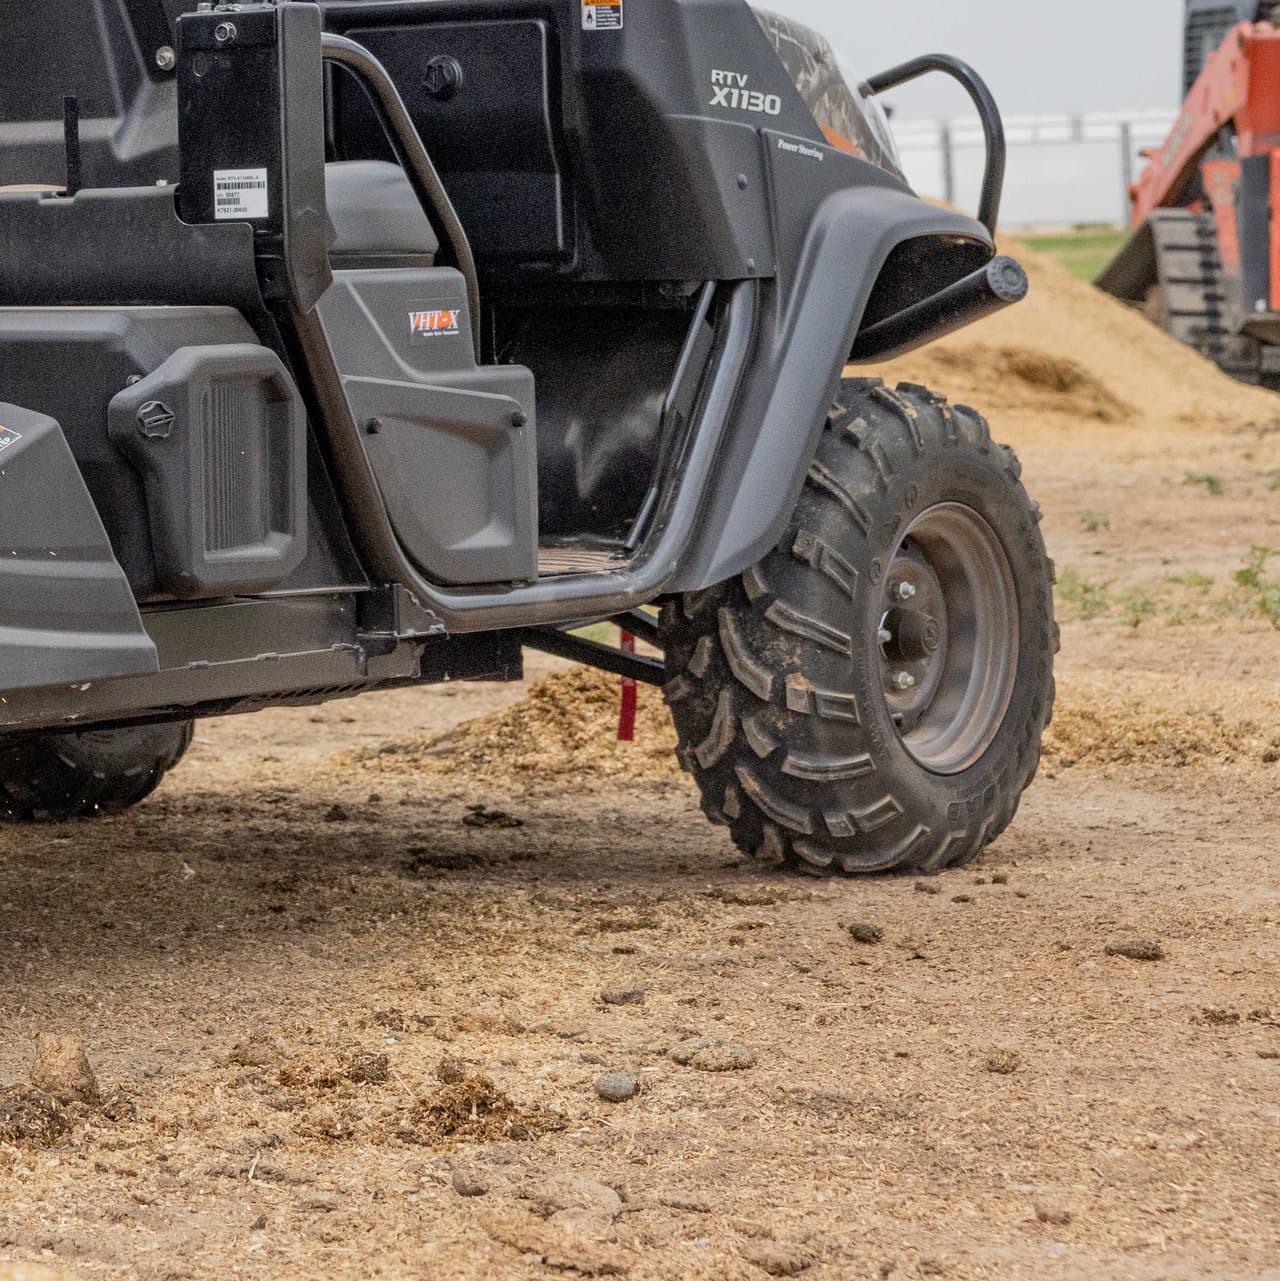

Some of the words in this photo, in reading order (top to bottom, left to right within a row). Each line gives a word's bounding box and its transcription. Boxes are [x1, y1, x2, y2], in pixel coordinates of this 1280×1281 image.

[710, 69, 748, 87] RTV
[708, 85, 782, 116] X1130
[777, 138, 799, 154] Power
[798, 143, 824, 162] Steering
